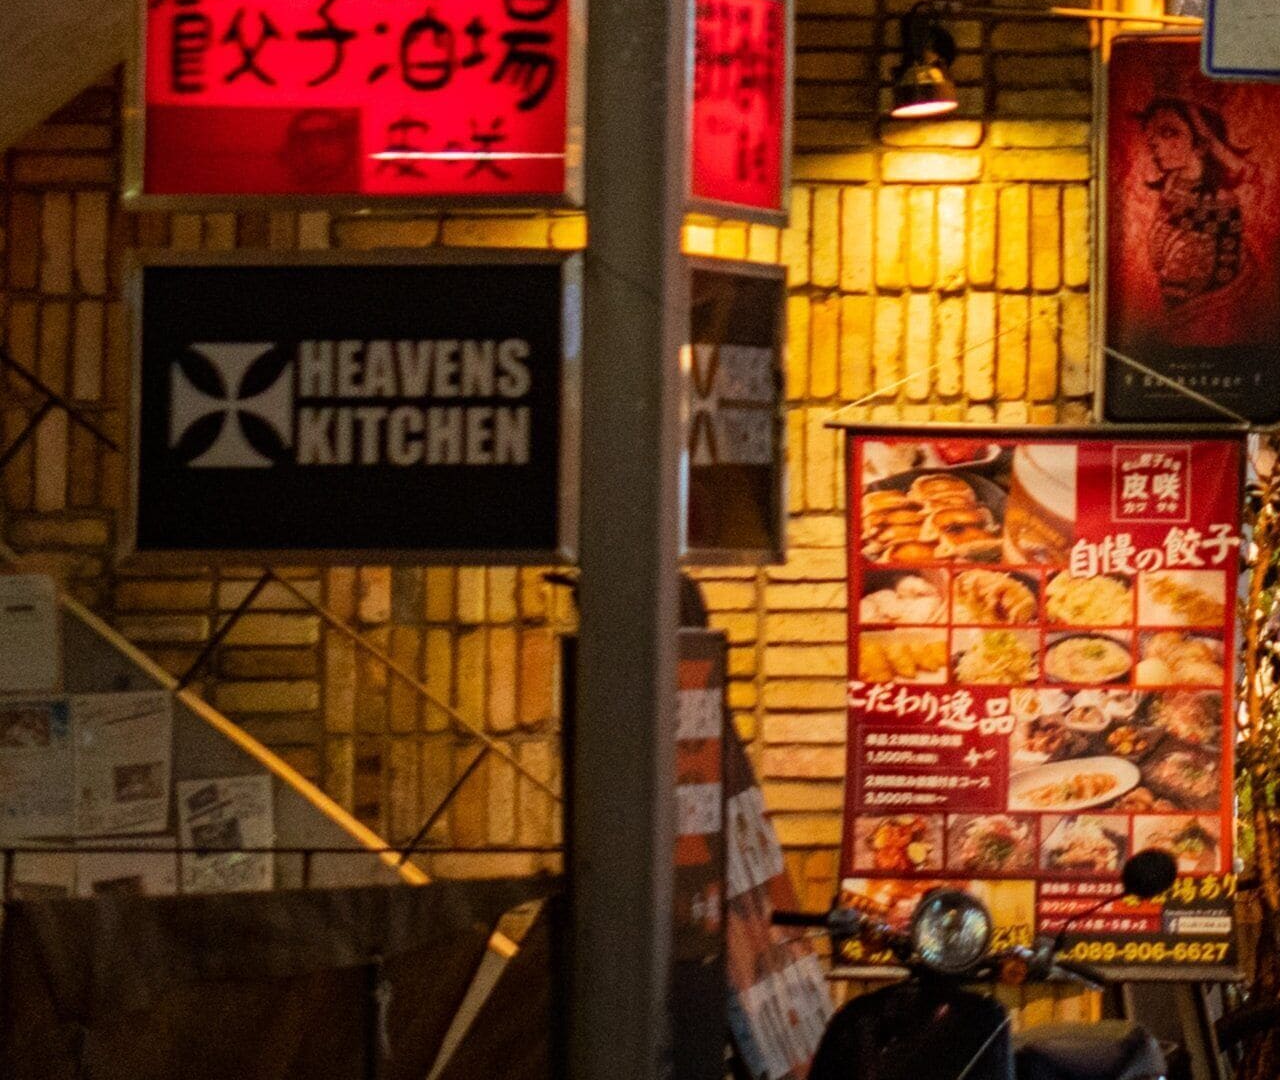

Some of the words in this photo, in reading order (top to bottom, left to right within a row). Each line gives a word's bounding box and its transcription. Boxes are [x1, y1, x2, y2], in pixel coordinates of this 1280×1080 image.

[302, 338, 532, 399] HEAVENS
[296, 406, 532, 466] KITCHEN
[1067, 522, 1240, 579] 自慢の餃子
[1074, 940, 1231, 962] 089-906-6627
